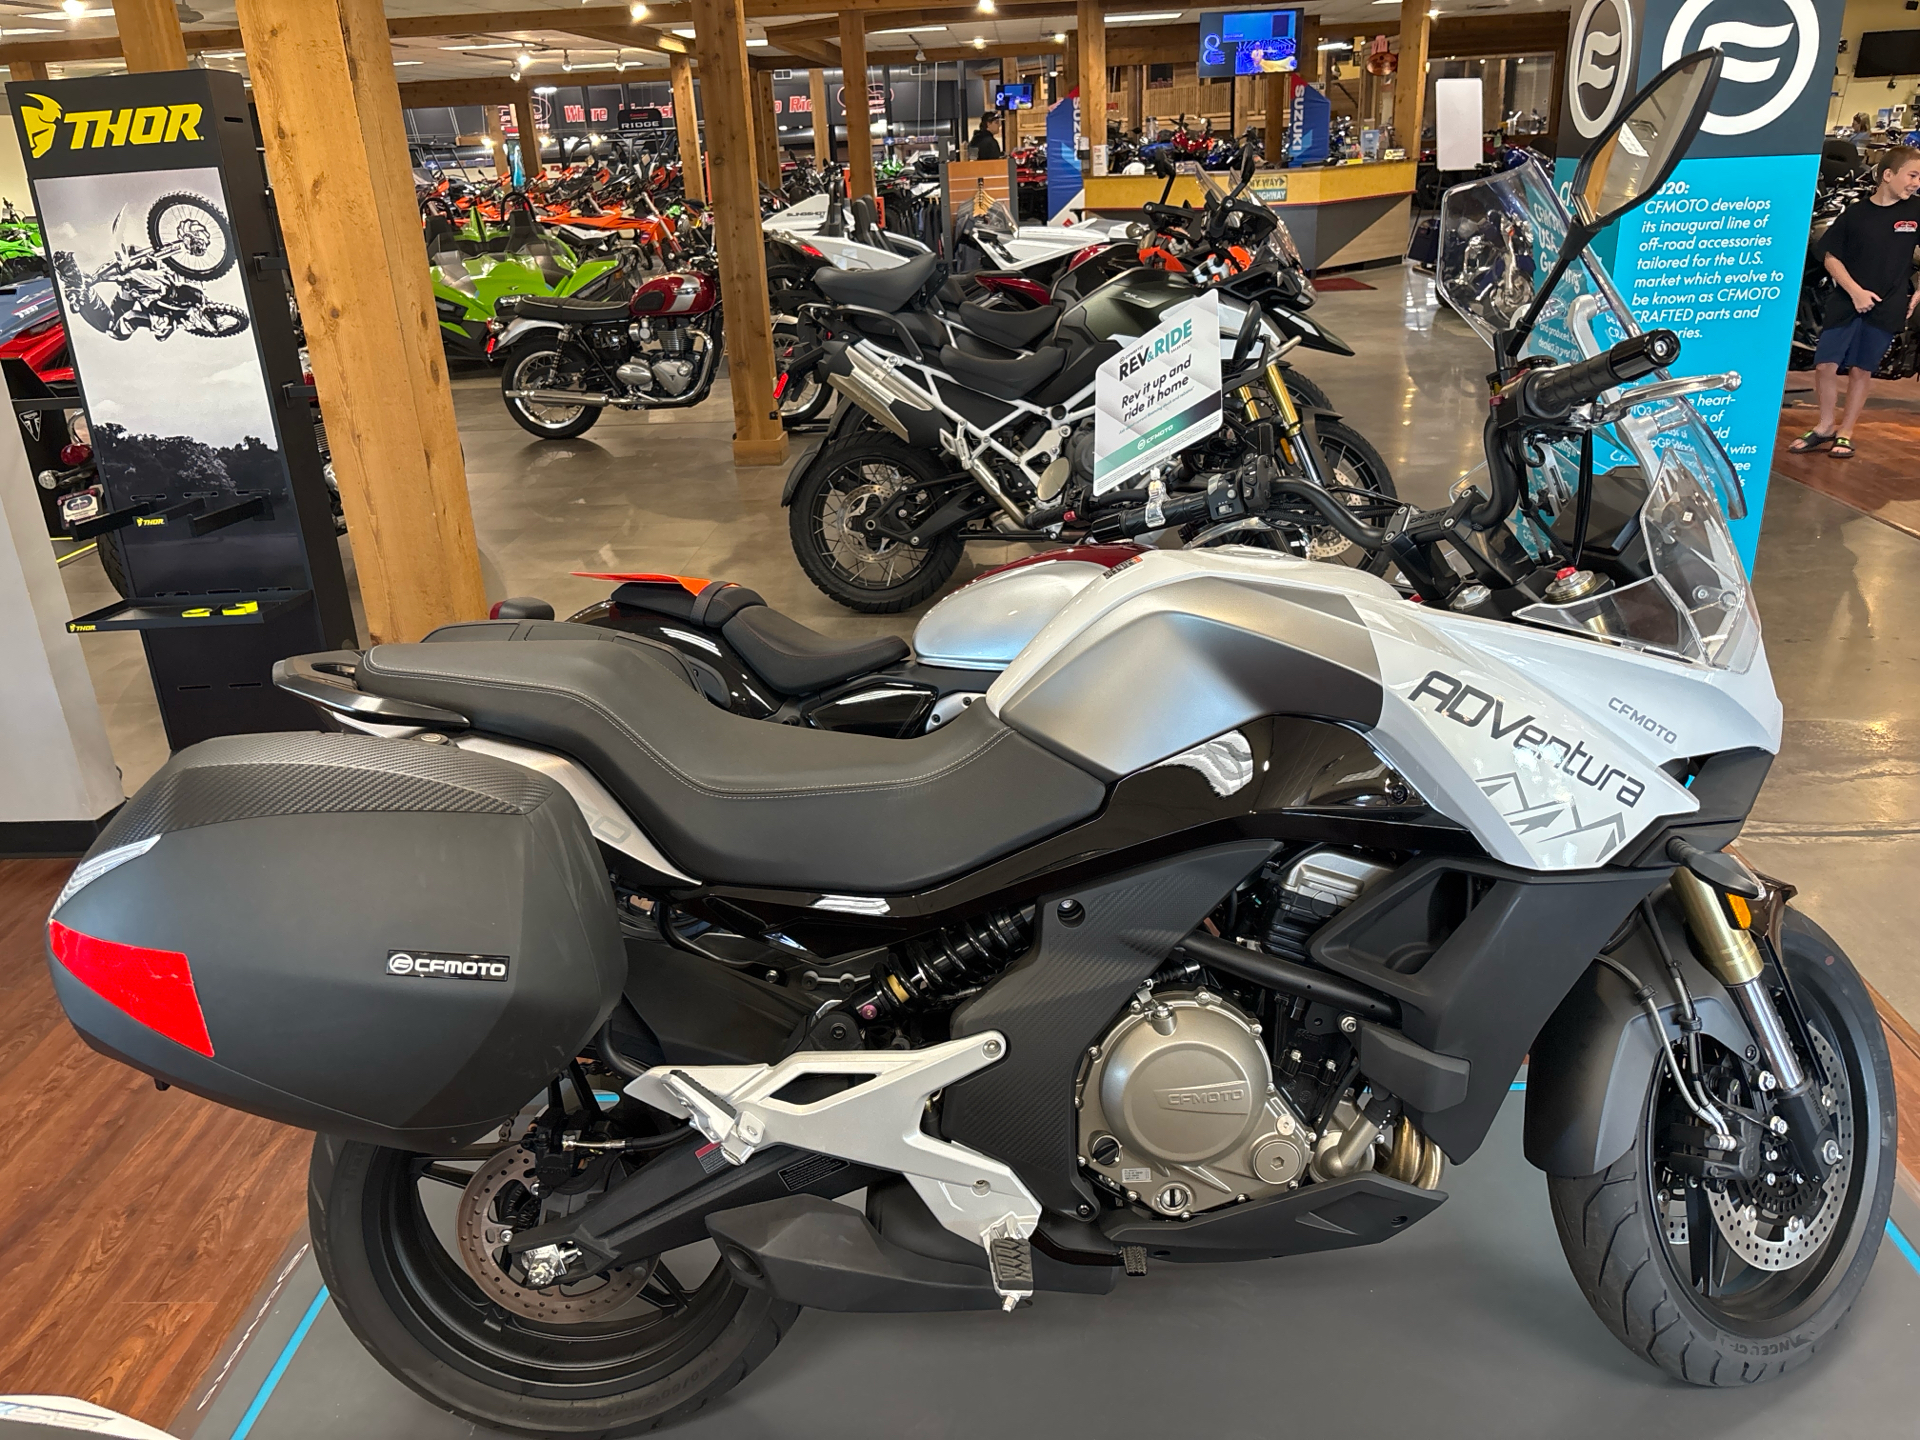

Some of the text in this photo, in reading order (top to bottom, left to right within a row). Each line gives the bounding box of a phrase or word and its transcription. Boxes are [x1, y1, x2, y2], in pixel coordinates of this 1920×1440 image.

[564, 105, 608, 122] Whre
[1292, 84, 1305, 150] SUZUKI
[64, 104, 203, 150] THOR
[621, 121, 660, 129] RIDGE
[1644, 196, 1771, 214] CFMOTO develops
[1641, 214, 1770, 235] its inaugural line of
[1639, 234, 1773, 251] off-road accessories
[1637, 251, 1764, 270] tailored for the U.S.
[1634, 269, 1784, 288] market which evolve to
[1632, 286, 1781, 306] be known as CFMOTO
[1632, 305, 1761, 324] CRAFTED parts and
[1122, 354, 1192, 409] Rev it up and
[1124, 376, 1189, 422] ride it home
[1697, 394, 1736, 406] heart-
[1710, 410, 1726, 423] of
[1146, 424, 1173, 443] CFMOTO
[1730, 444, 1757, 454] wins
[143, 517, 165, 526] THOR
[1608, 697, 1678, 745] CFMOTO
[1407, 670, 1647, 808] ADVentura
[414, 958, 507, 976] CFMOTO
[1168, 1089, 1245, 1106] CFMOTO
